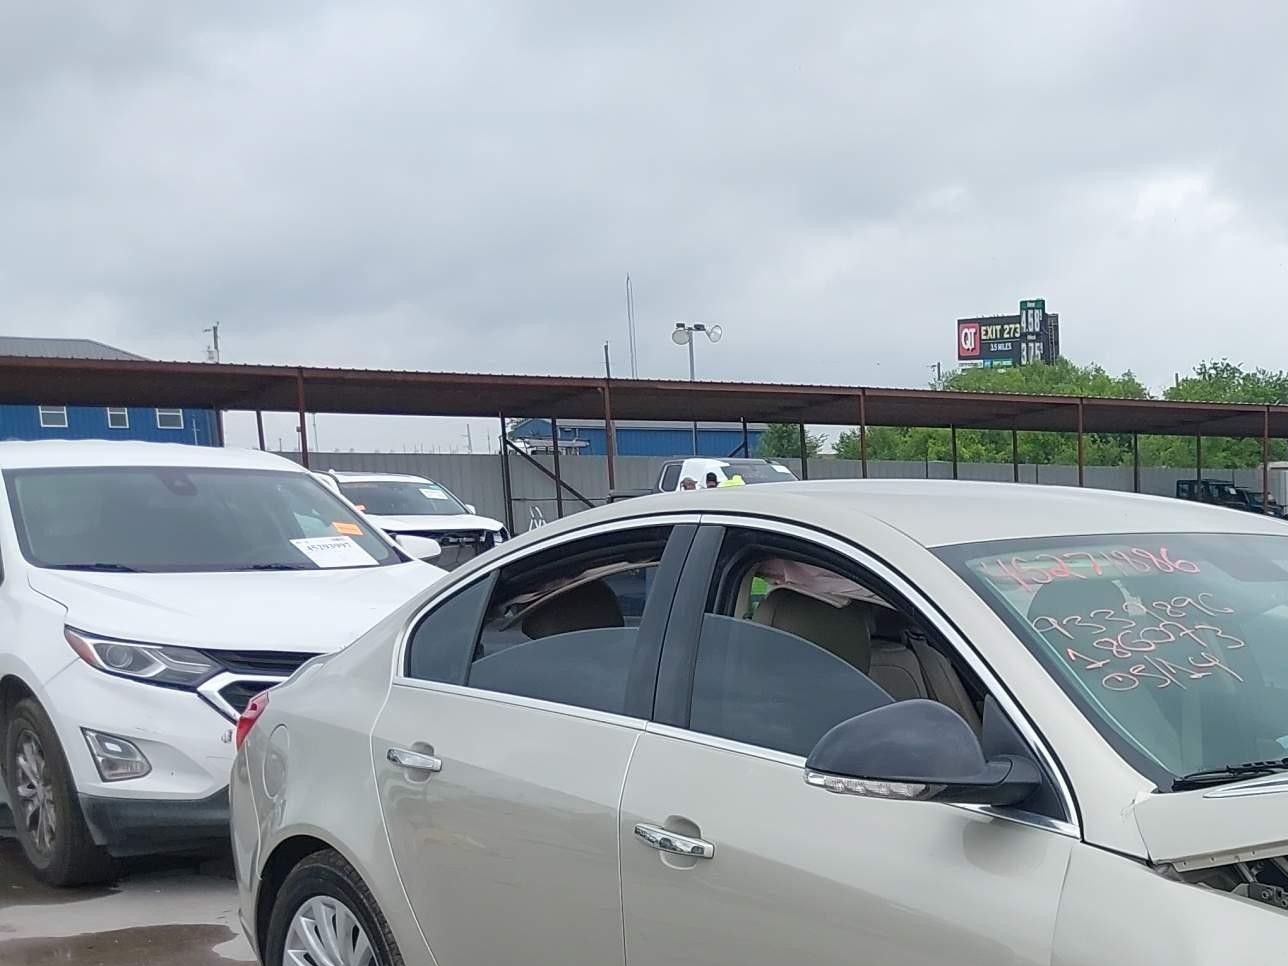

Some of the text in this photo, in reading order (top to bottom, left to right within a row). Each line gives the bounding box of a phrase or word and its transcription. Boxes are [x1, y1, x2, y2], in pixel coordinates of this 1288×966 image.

[962, 328, 977, 352] QT
[981, 323, 1020, 340] EXIT 273
